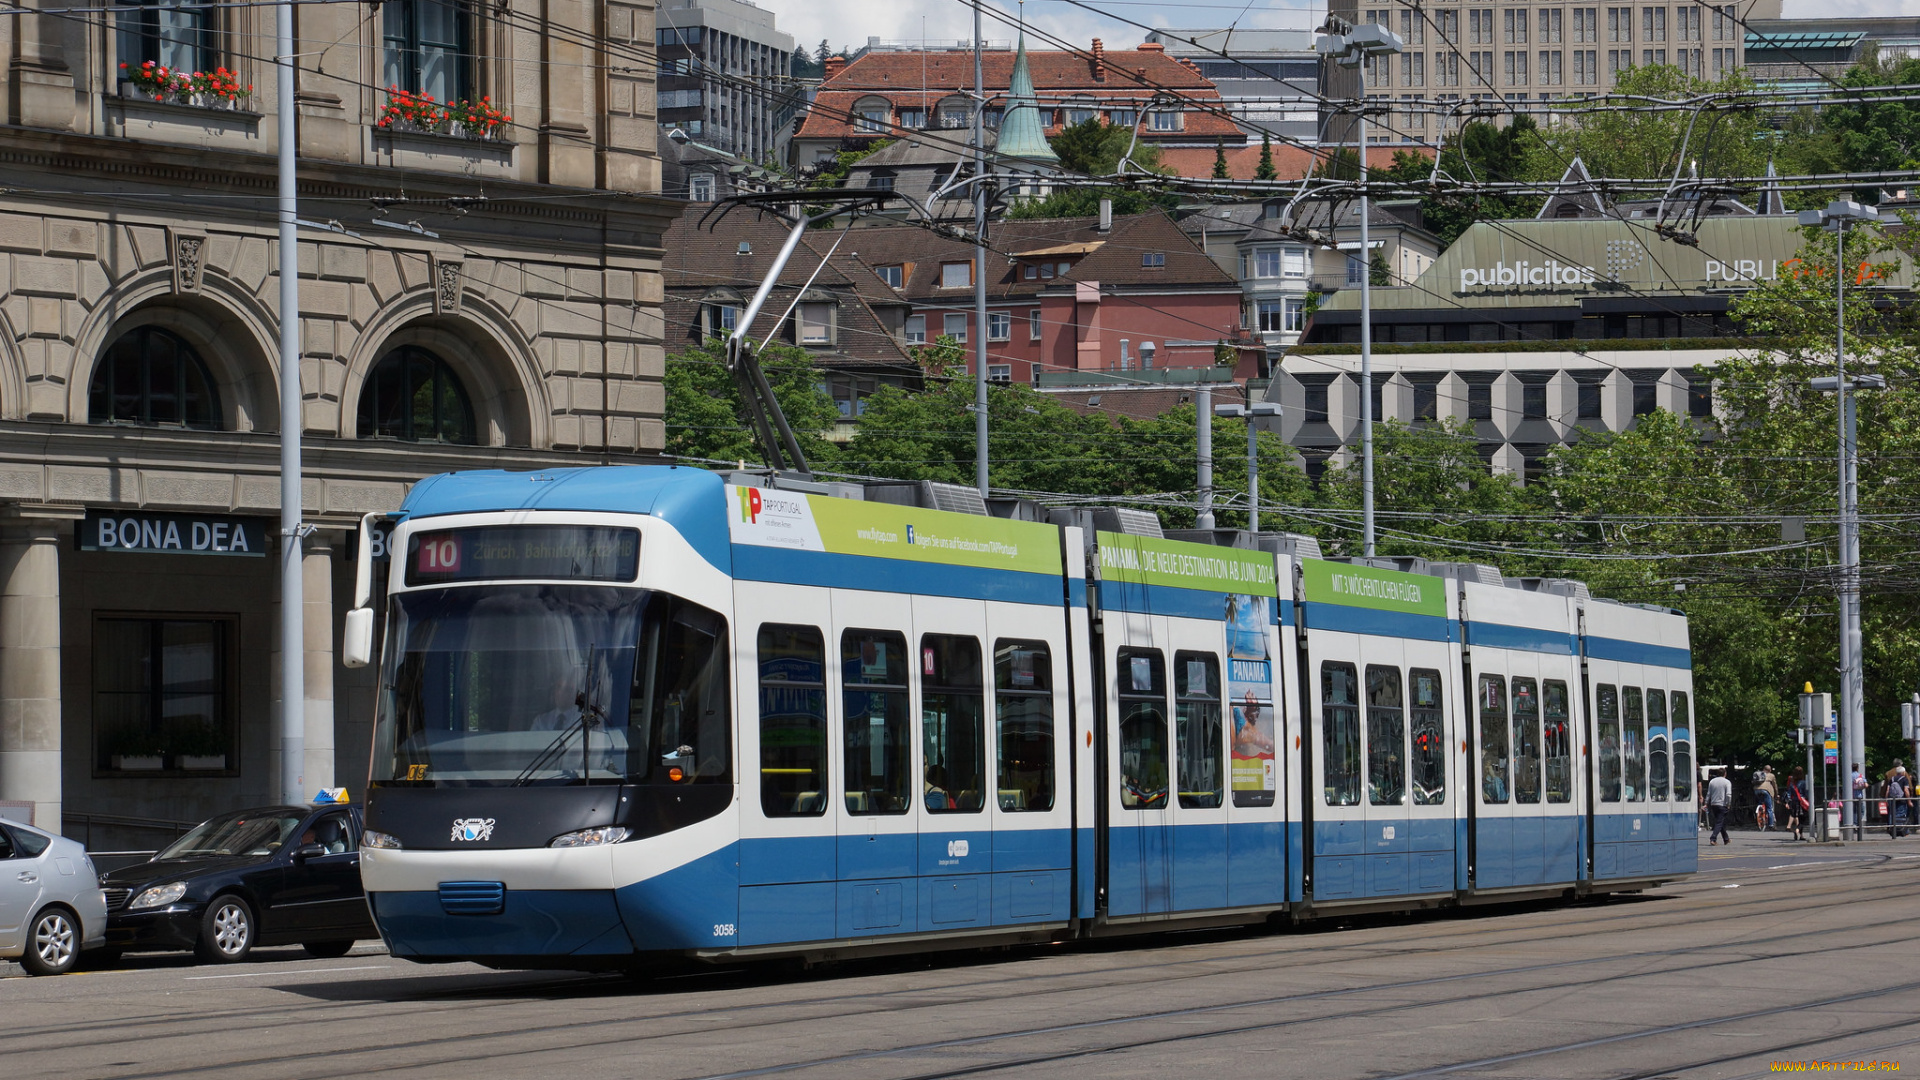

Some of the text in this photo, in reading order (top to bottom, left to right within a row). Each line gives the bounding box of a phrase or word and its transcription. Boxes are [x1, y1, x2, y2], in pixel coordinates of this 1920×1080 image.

[1460, 260, 1595, 292] publicitas
[736, 486, 762, 524] TAP
[98, 517, 249, 552] BONA DEA
[857, 527, 898, 544] www.flytap.com
[425, 540, 457, 567] 10
[1101, 546, 1274, 584] PANAMA, DIE NEUE DESTINATION AB JUNI 2014
[1332, 573, 1421, 603] MIT 3 WÖCHENTLICHEN FLÜGEN
[924, 652, 934, 670] 10
[1233, 661, 1266, 682] PANAMA
[320, 791, 338, 799] TAXI
[713, 924, 734, 936] 3058
